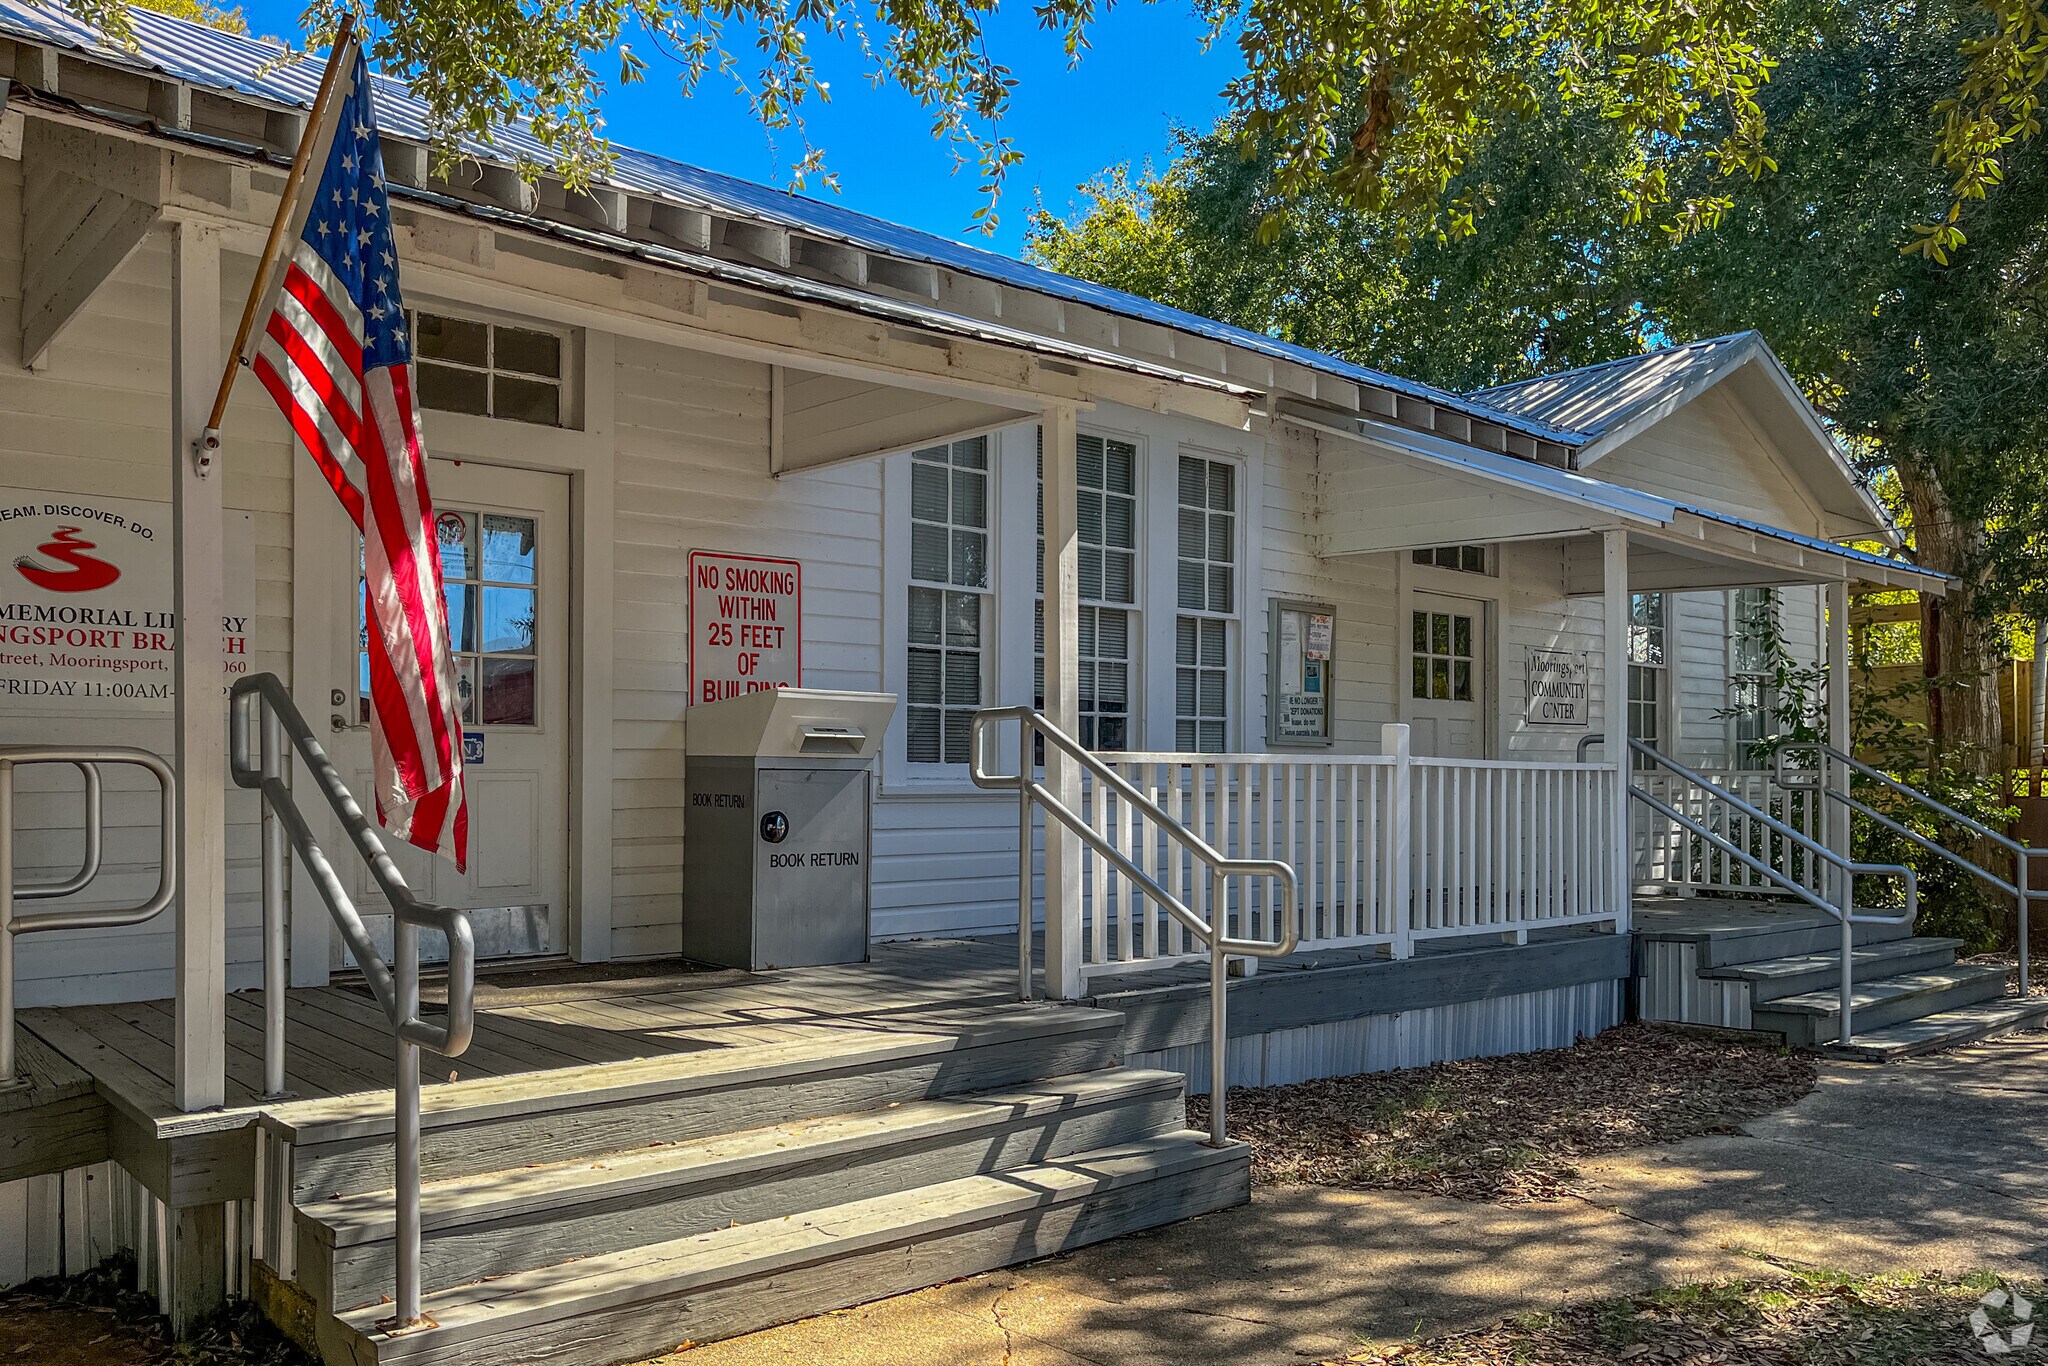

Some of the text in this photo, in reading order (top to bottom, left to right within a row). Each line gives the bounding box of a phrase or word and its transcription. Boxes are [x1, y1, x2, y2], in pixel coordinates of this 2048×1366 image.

[44, 504, 126, 529] DISCOVER.
[130, 522, 154, 541] DO.
[697, 564, 794, 595] NO SMOKING
[0, 603, 138, 627] MEMORIAL
[718, 594, 776, 621] WITHIN
[708, 622, 785, 649] 25 FEET
[49, 652, 168, 673] Mooringsport,
[737, 652, 760, 676] OF
[1531, 680, 1586, 699] COMMUNITY
[1294, 696, 1300, 705] NO
[1301, 696, 1319, 705] LONGER
[1300, 707, 1324, 715] DONATIONS
[1542, 701, 1575, 720] CNTER
[692, 793, 745, 809] BOOK RETURN
[770, 852, 859, 868] BOOK RETURN
